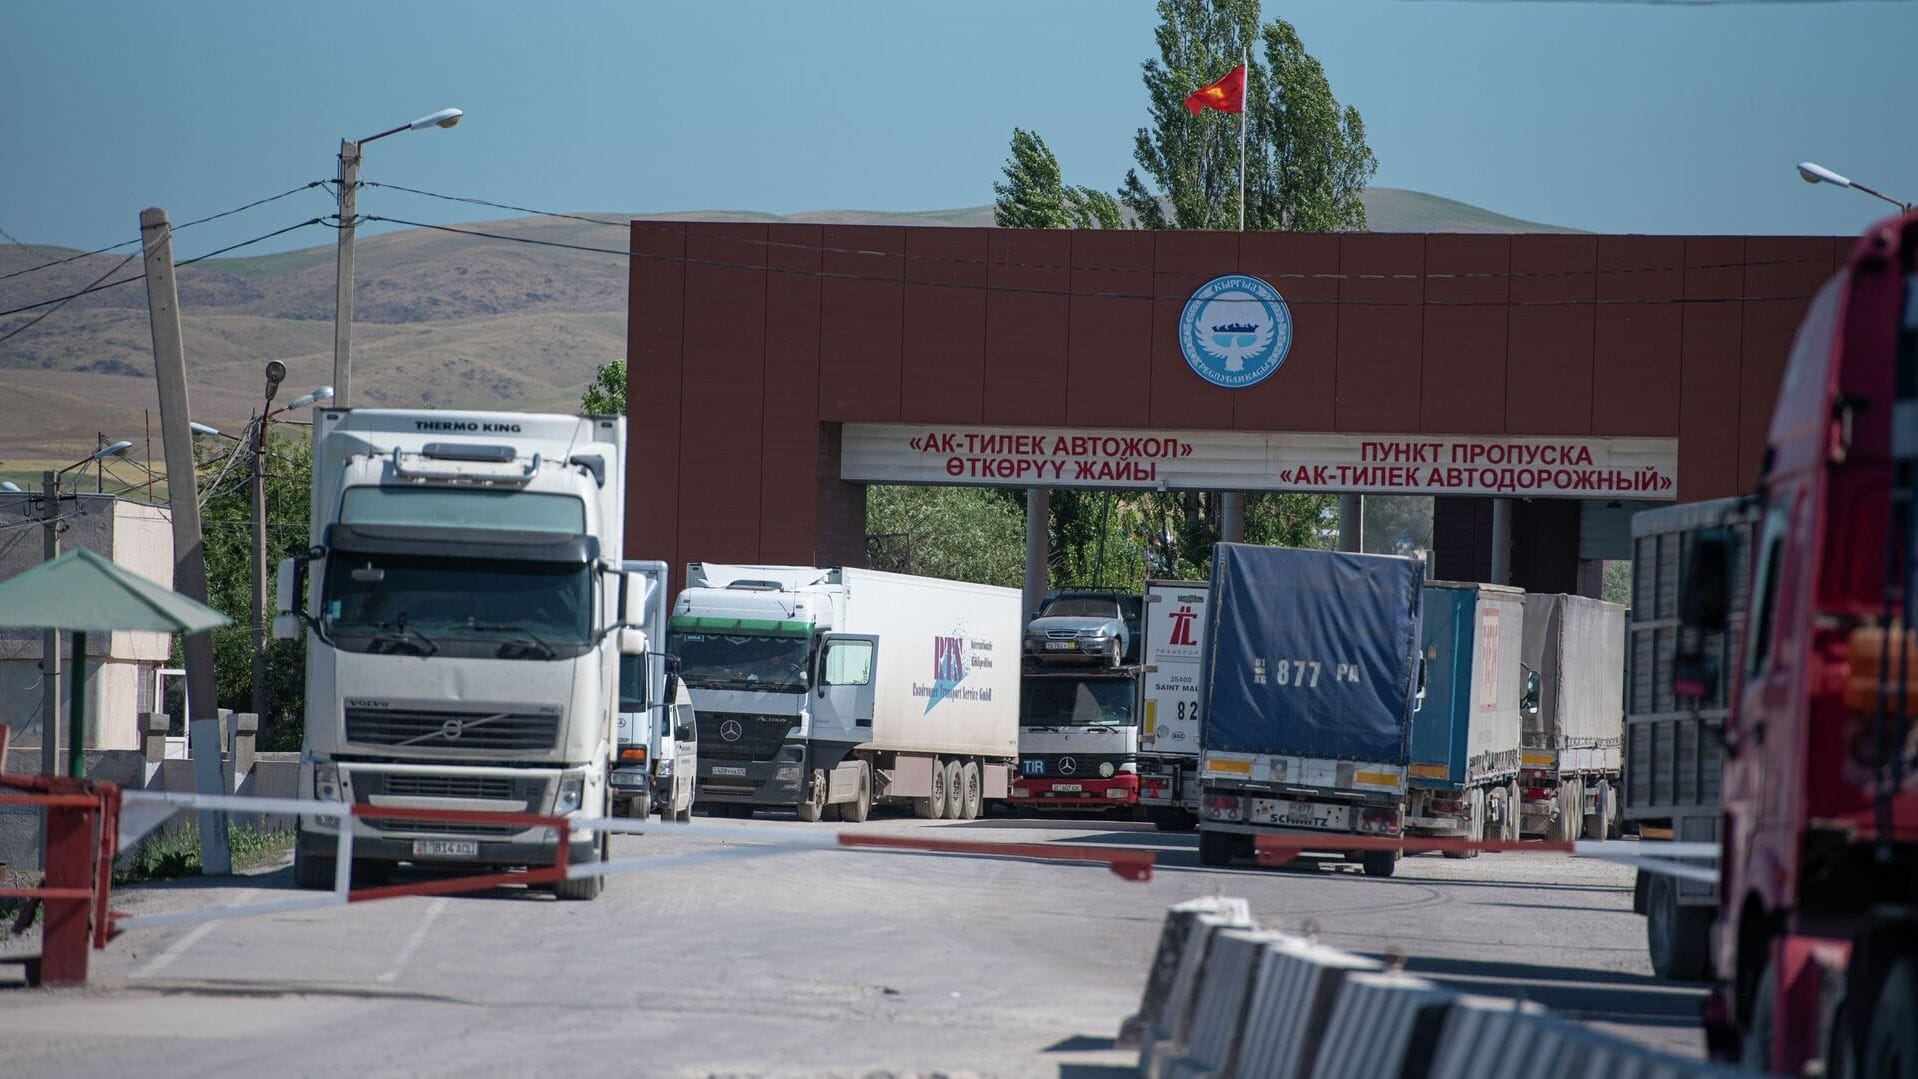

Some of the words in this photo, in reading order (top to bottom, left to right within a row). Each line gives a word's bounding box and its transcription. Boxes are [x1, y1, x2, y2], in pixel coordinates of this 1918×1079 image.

[1213, 279, 1258, 292] КЫРГЫЗ
[1198, 361, 1272, 384] РЕСПУБЛИКАСЫ
[415, 421, 478, 431] THERMO
[482, 423, 522, 433] KING
[909, 432, 1046, 456] «АК-ТИЛЕК
[1051, 435, 1194, 459] АВТОЖОЛ»
[1360, 441, 1443, 464] ПУНКТ
[1451, 443, 1593, 466] ПРОПУСКА
[1074, 455, 1157, 481] ЖАЙЫ
[1279, 464, 1419, 487] «АК-ТИЛЕК
[1426, 466, 1673, 492] АВТОДОРОЖНЫЙ»
[1277, 659, 1322, 688] 877
[1336, 663, 1360, 683] PA
[350, 700, 389, 708] VOLVO
[940, 684, 962, 702] Transport
[962, 686, 978, 700] Service
[1023, 760, 1044, 774] TIR
